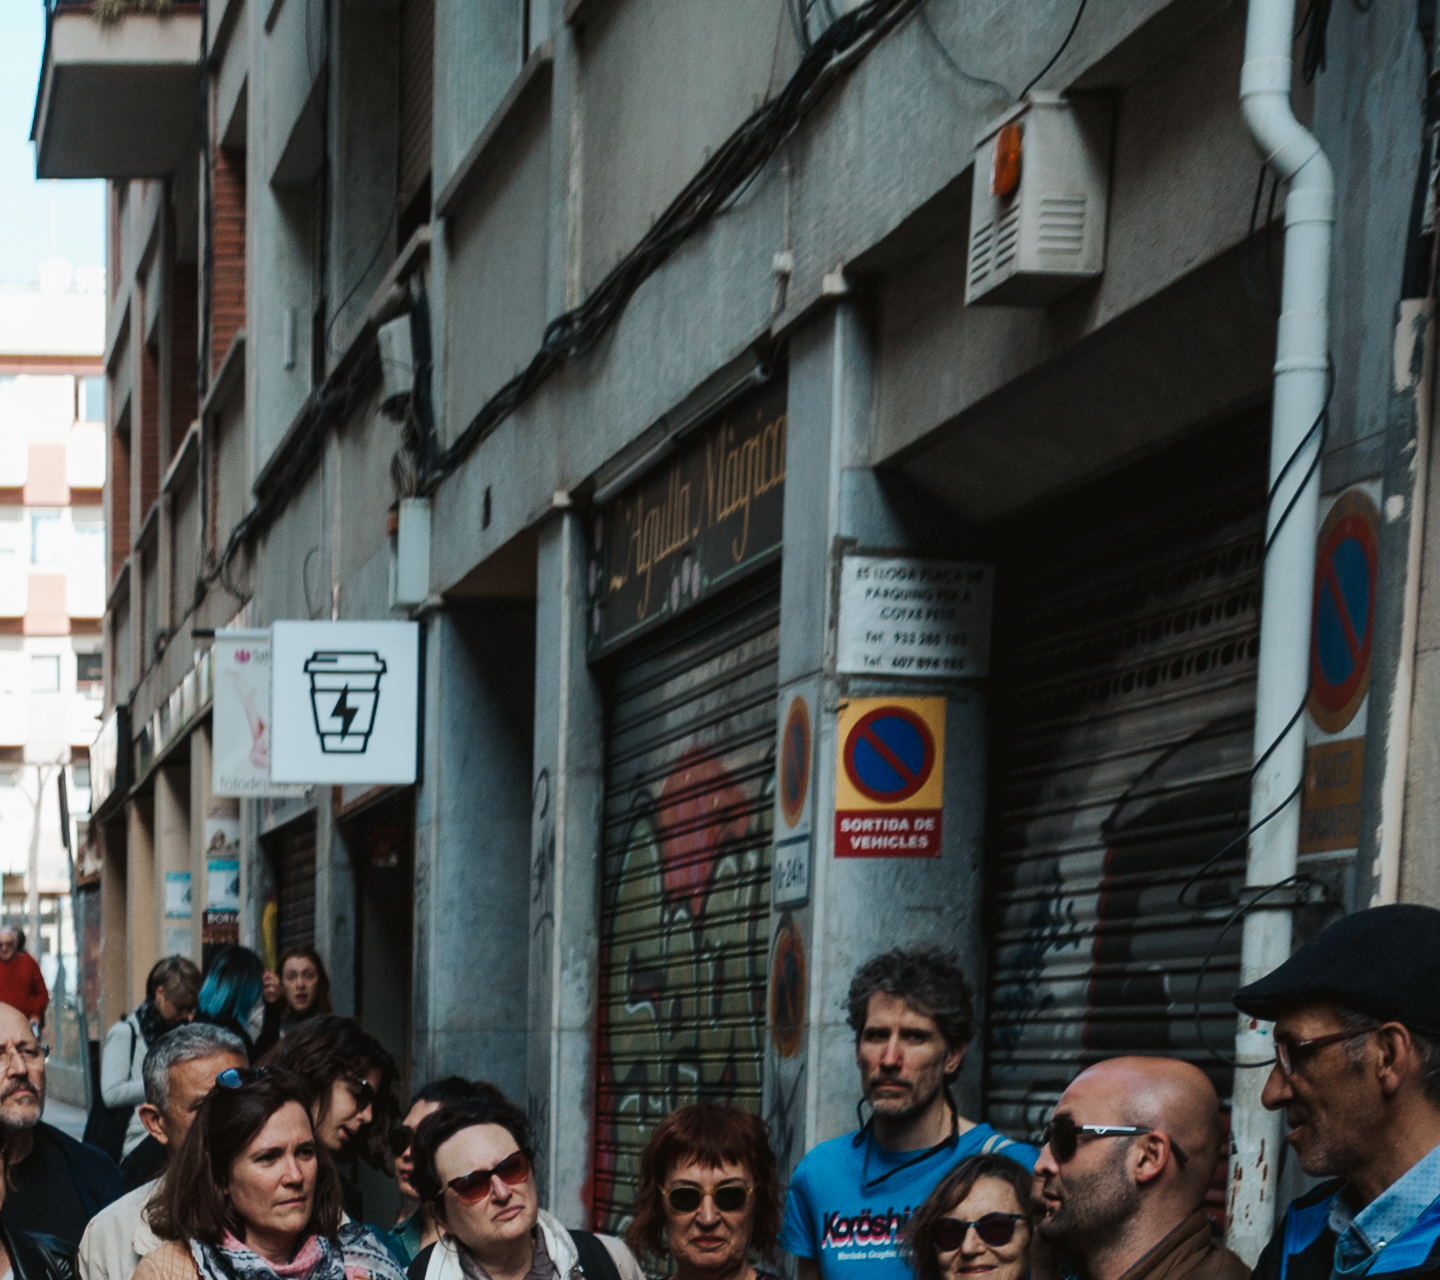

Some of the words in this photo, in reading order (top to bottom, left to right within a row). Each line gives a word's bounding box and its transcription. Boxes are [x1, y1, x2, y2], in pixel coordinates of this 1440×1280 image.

[840, 817, 910, 832] SORTIDA
[914, 817, 935, 831] DE
[850, 835, 929, 850] VEHICLES
